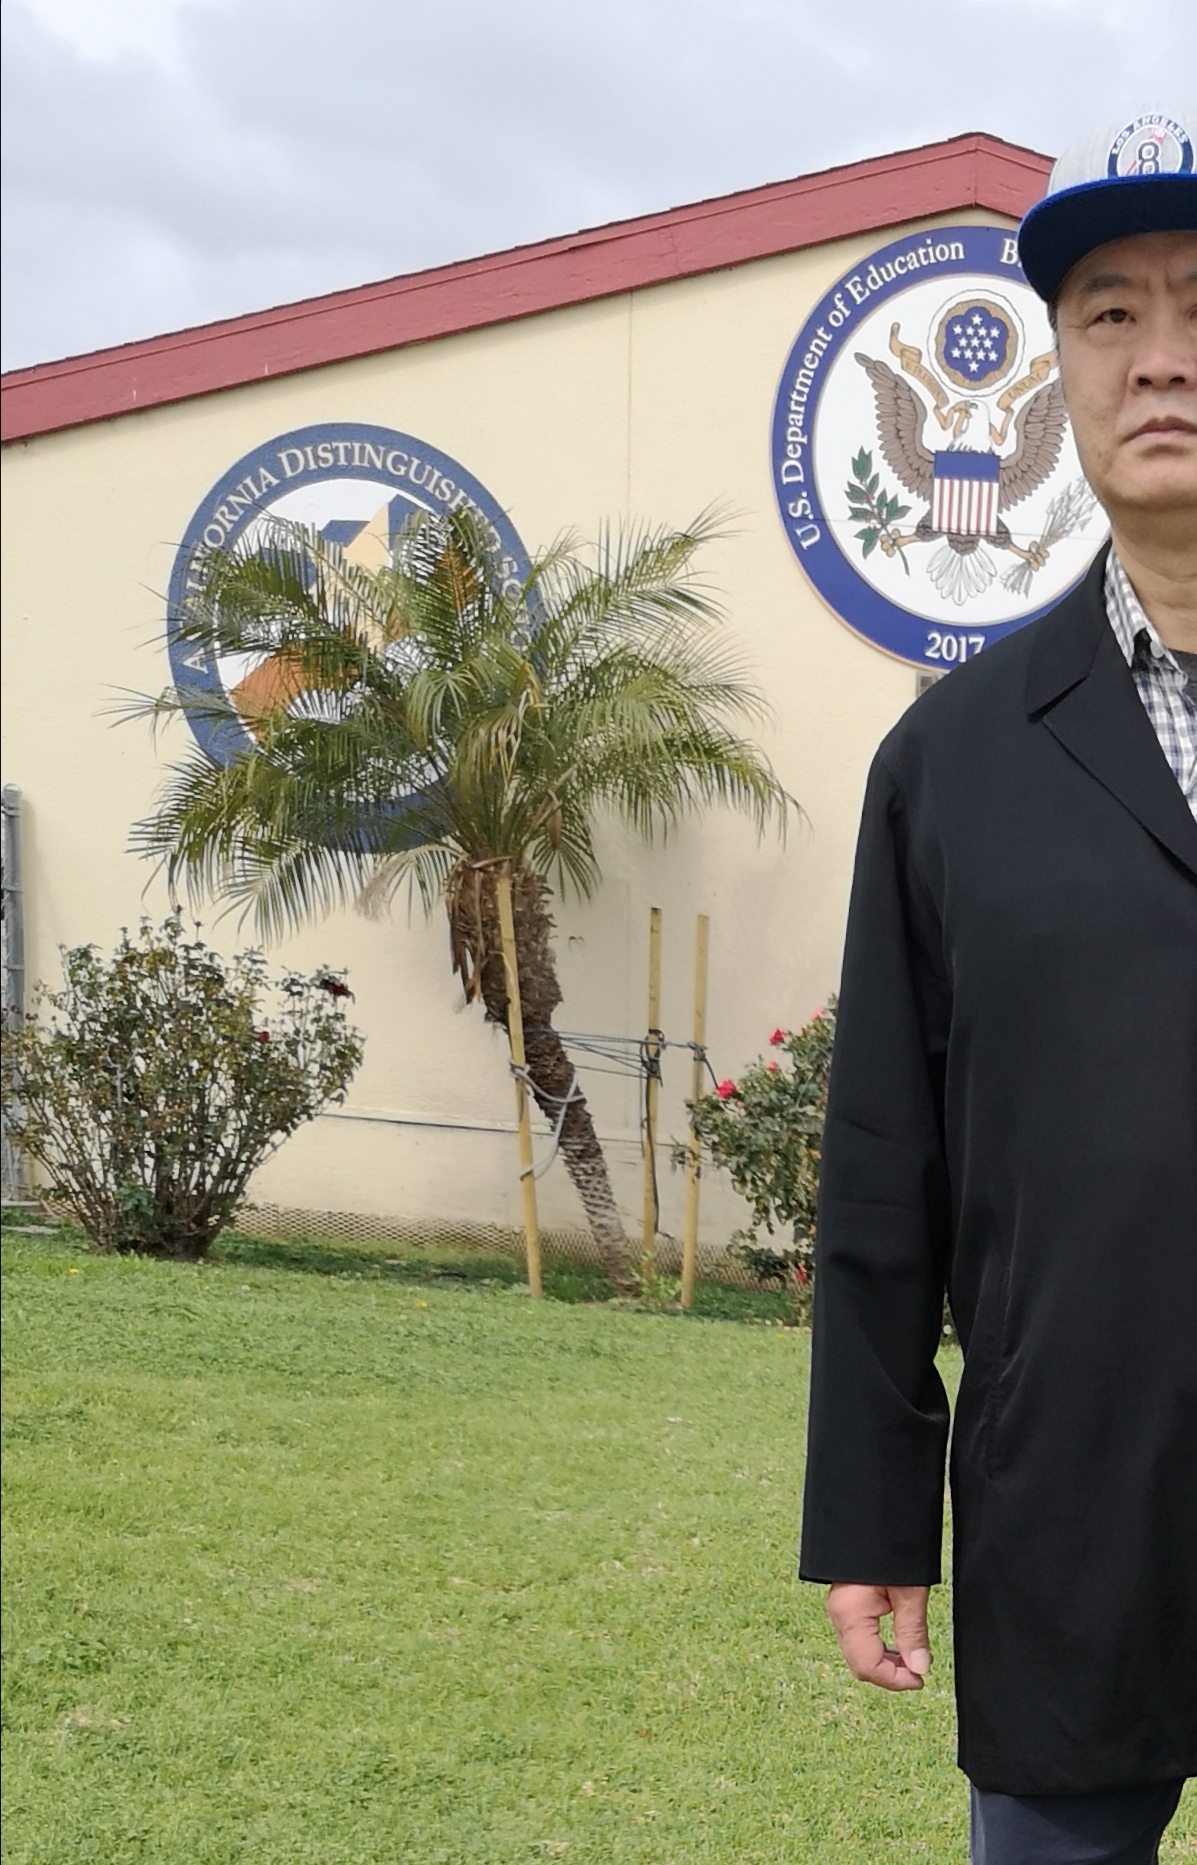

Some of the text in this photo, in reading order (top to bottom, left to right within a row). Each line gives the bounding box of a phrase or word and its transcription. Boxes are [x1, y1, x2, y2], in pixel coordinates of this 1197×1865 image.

[782, 239, 965, 550] U.S. Department of Education
[181, 467, 279, 632] ALIFORNIA
[925, 632, 985, 662] 2017
